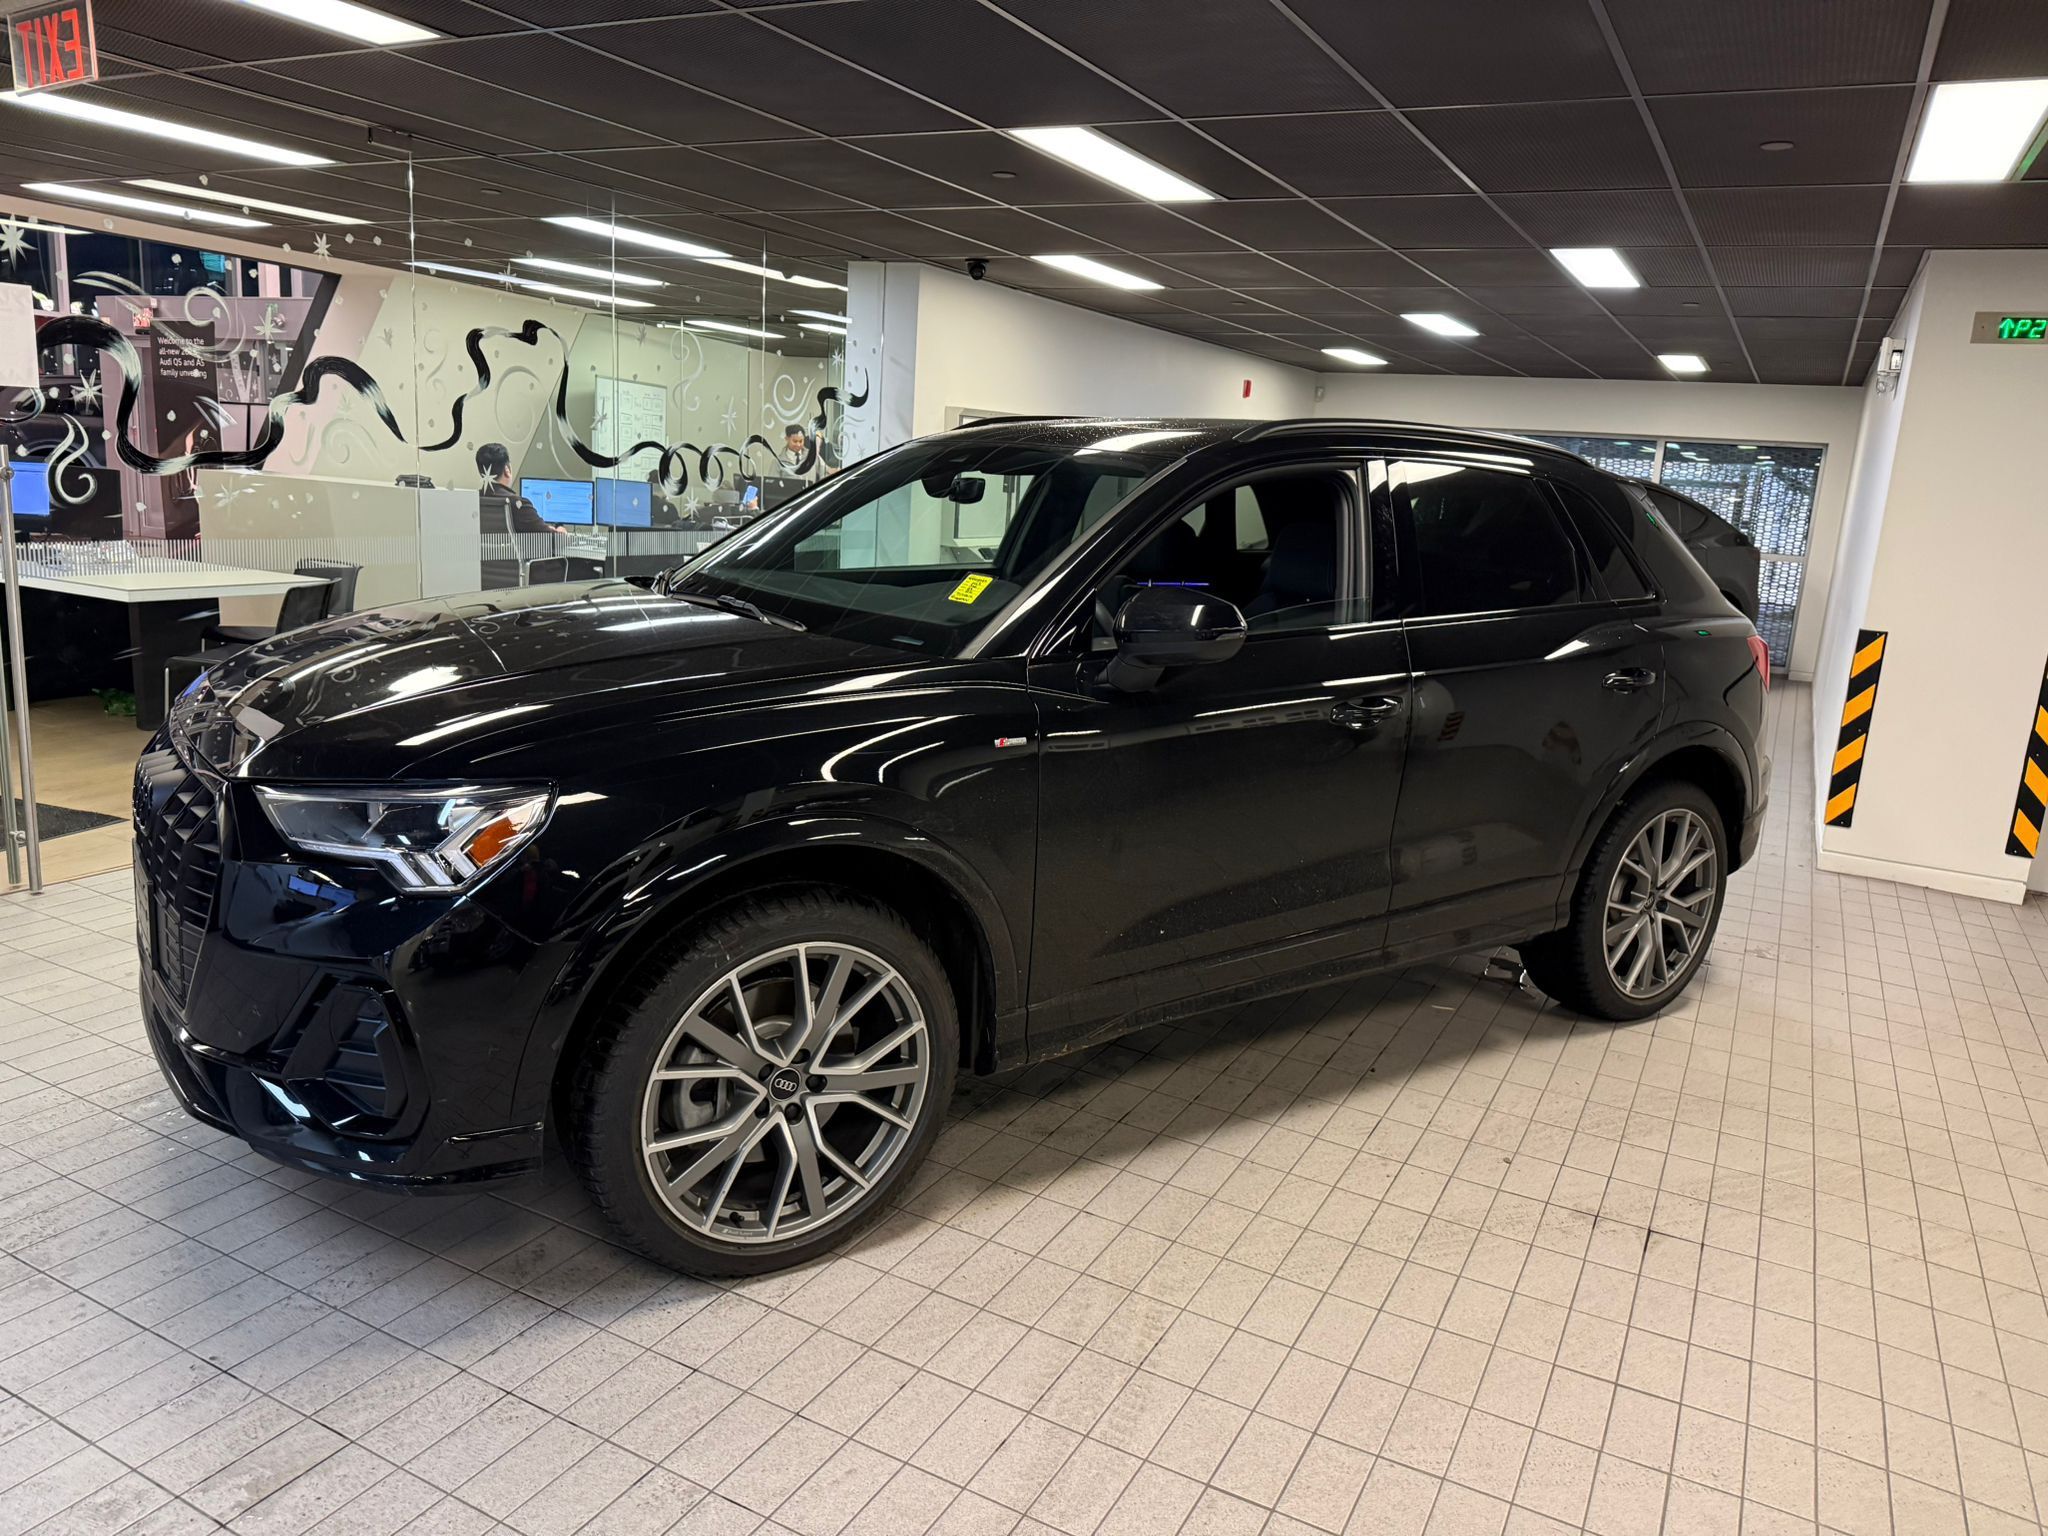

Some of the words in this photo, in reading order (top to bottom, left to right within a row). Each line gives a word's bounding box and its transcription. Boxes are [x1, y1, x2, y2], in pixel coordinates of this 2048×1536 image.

[2013, 319, 2047, 338] P2
[157, 336, 185, 345] Welcome
[186, 337, 193, 345] to
[193, 337, 205, 345] the
[160, 357, 173, 366] Audi
[183, 358, 195, 366] and
[160, 367, 178, 378] family
[179, 369, 207, 379] unveng
